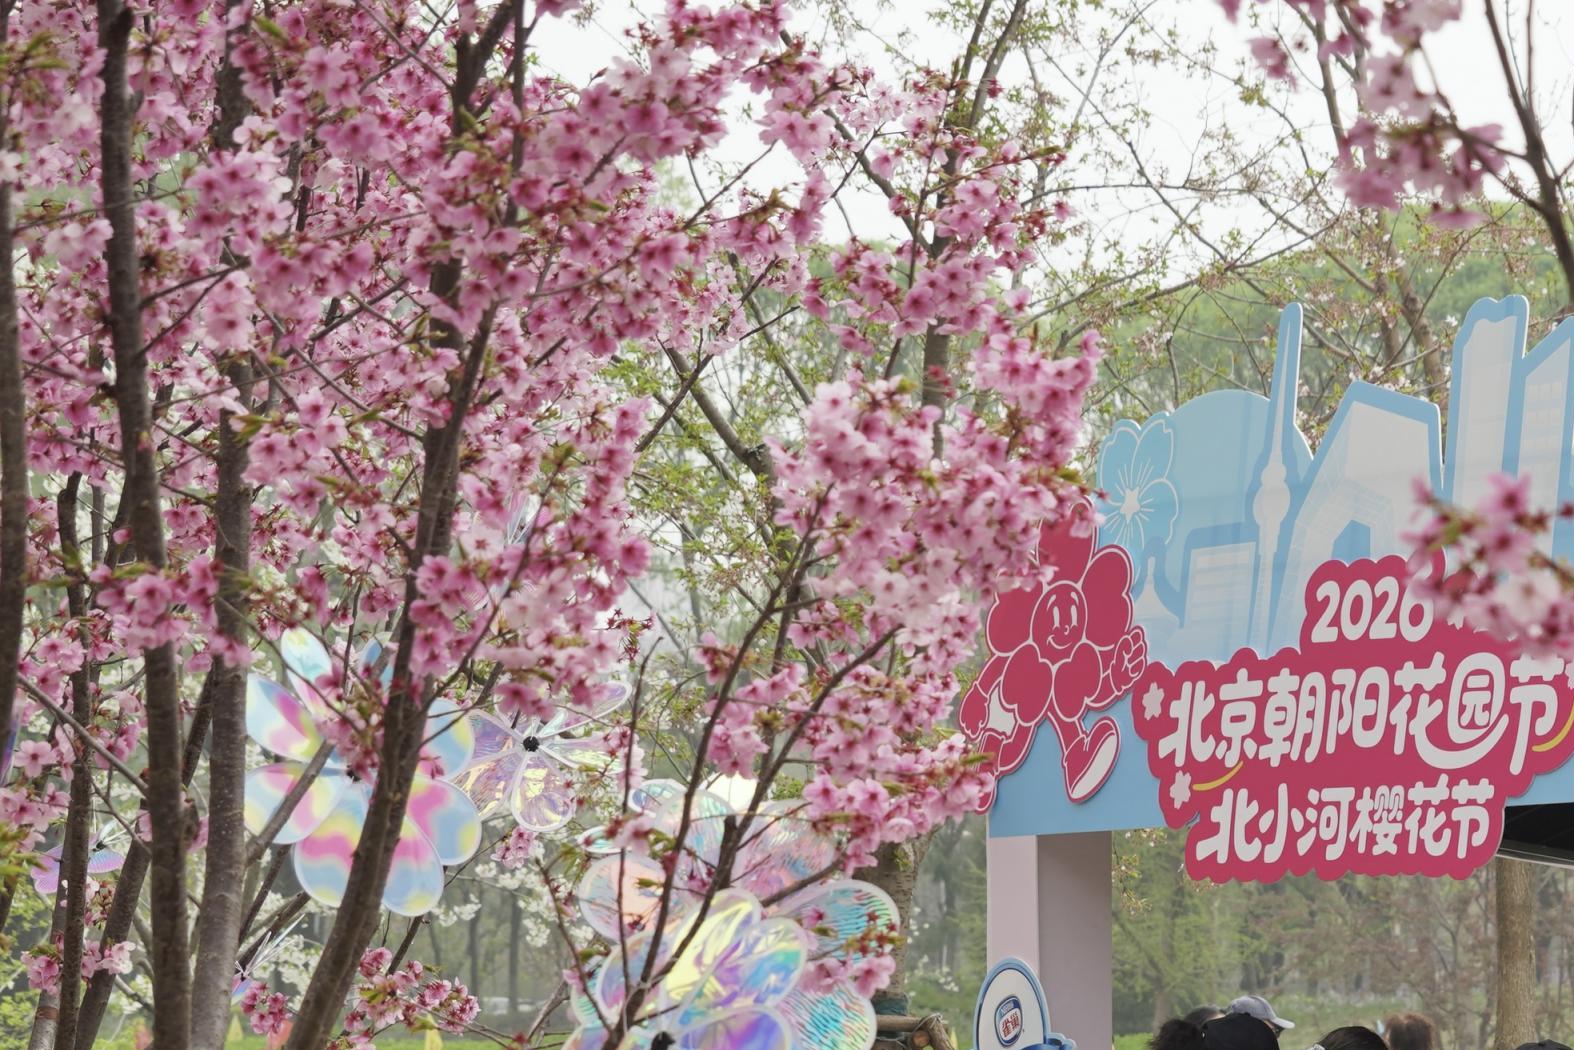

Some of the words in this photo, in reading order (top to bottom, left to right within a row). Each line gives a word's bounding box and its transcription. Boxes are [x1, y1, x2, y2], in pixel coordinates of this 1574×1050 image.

[1311, 564, 1434, 642] 2026
[1158, 651, 1564, 775] 北京朝阳花园节
[1197, 774, 1495, 864] 北小河樱花节
